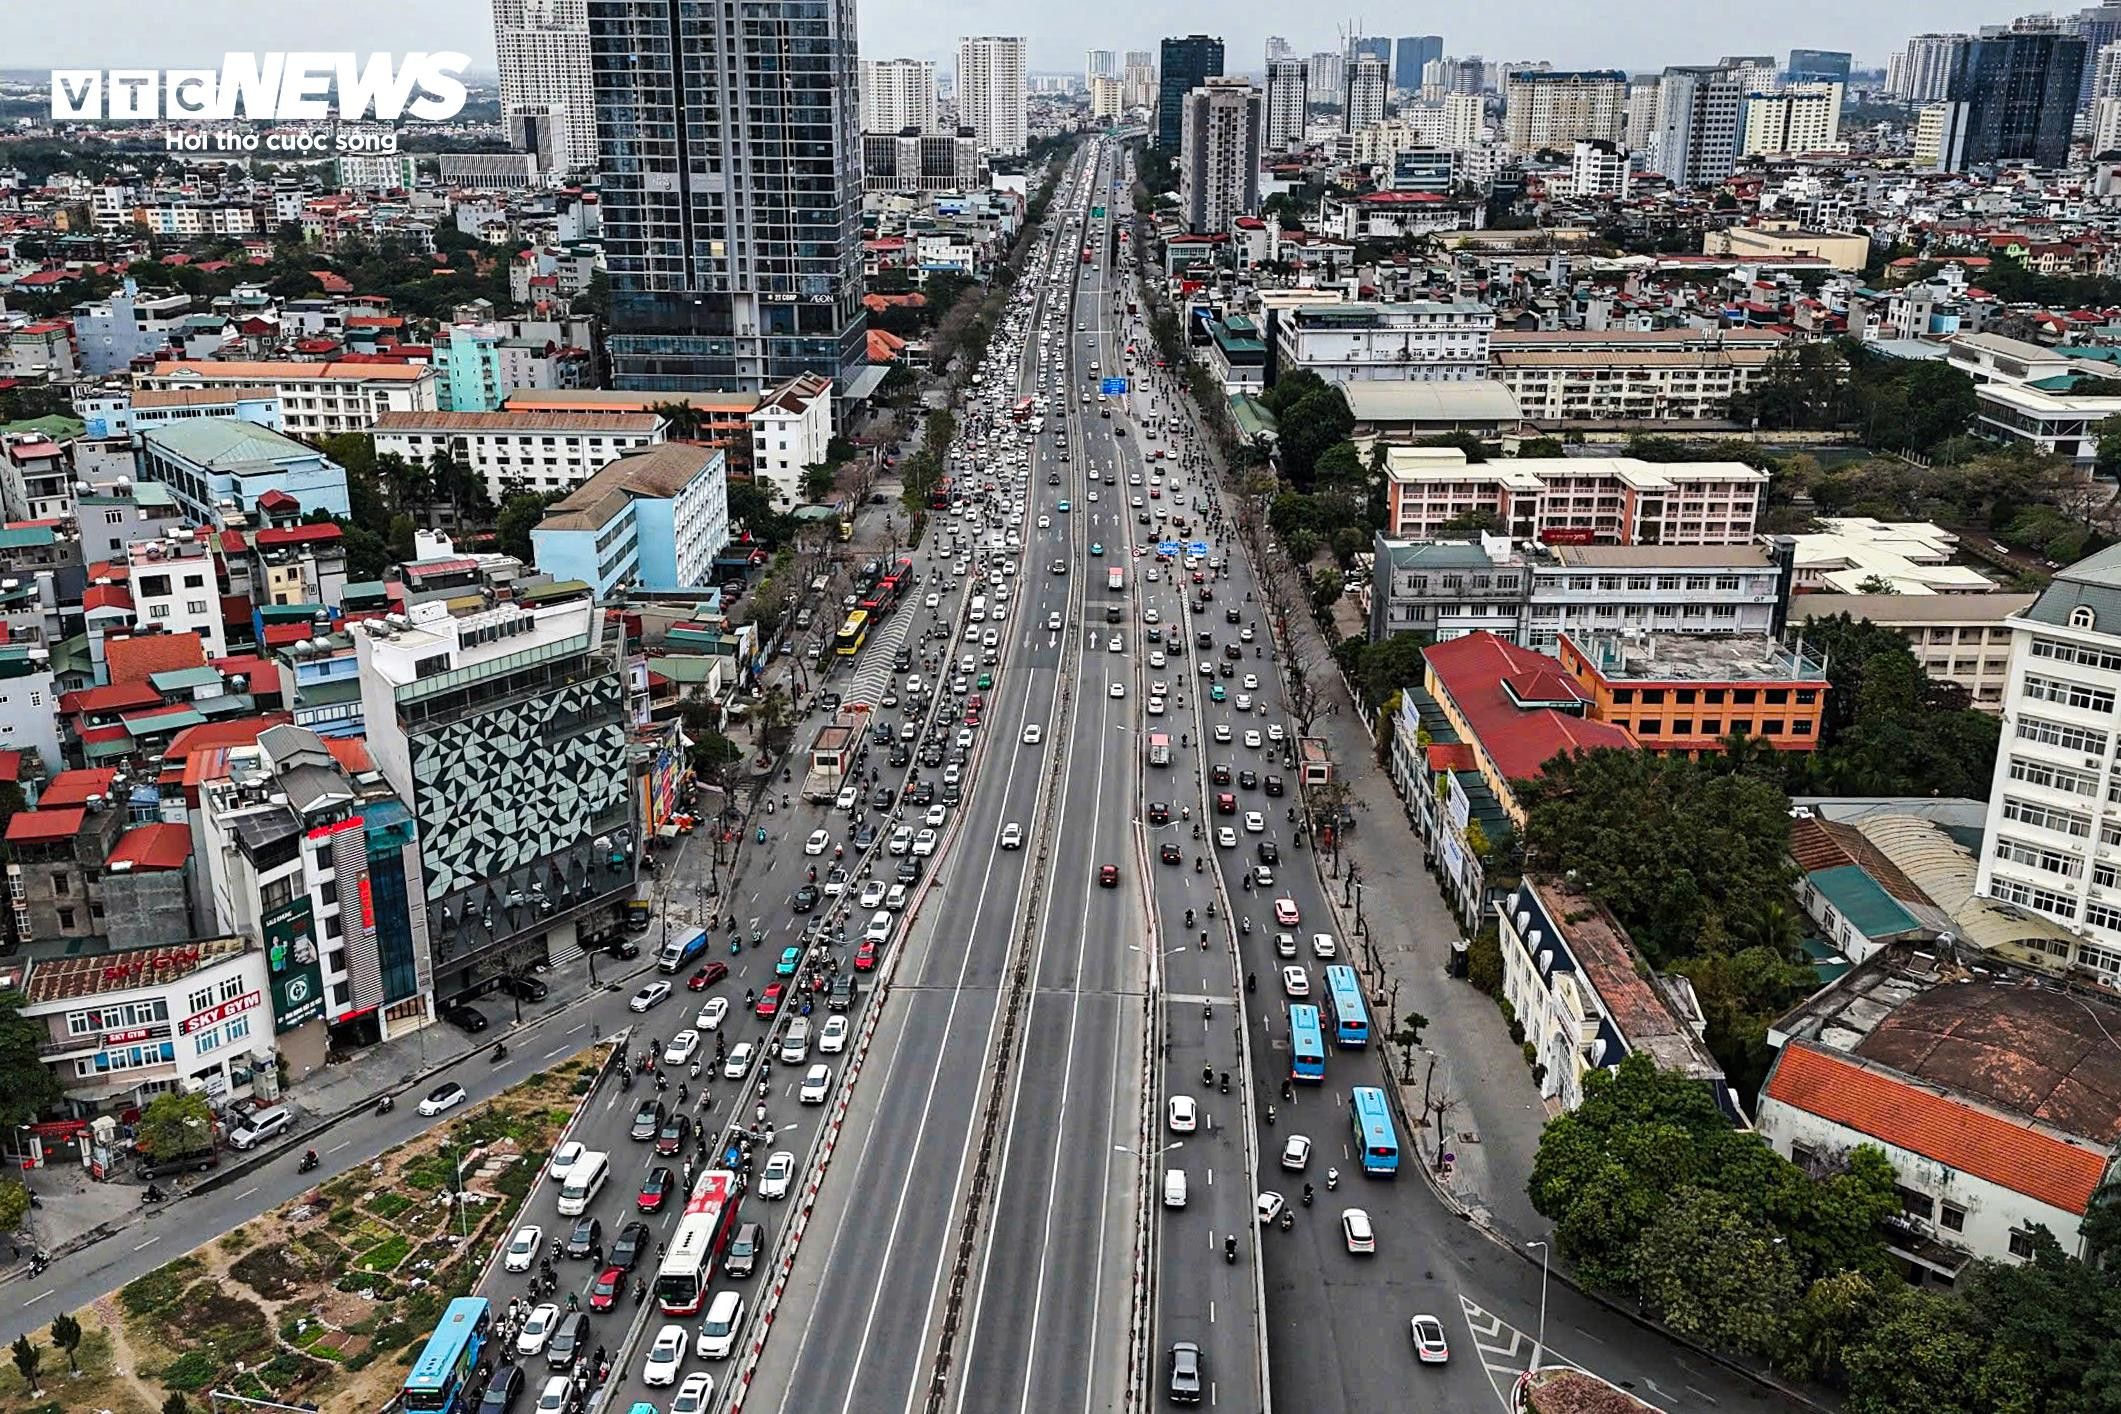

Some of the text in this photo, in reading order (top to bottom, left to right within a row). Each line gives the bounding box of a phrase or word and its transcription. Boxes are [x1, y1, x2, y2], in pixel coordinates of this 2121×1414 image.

[188, 1008, 219, 1032] SKY
[224, 992, 260, 1016] GYM
[109, 1029, 146, 1042] SKY GYM
